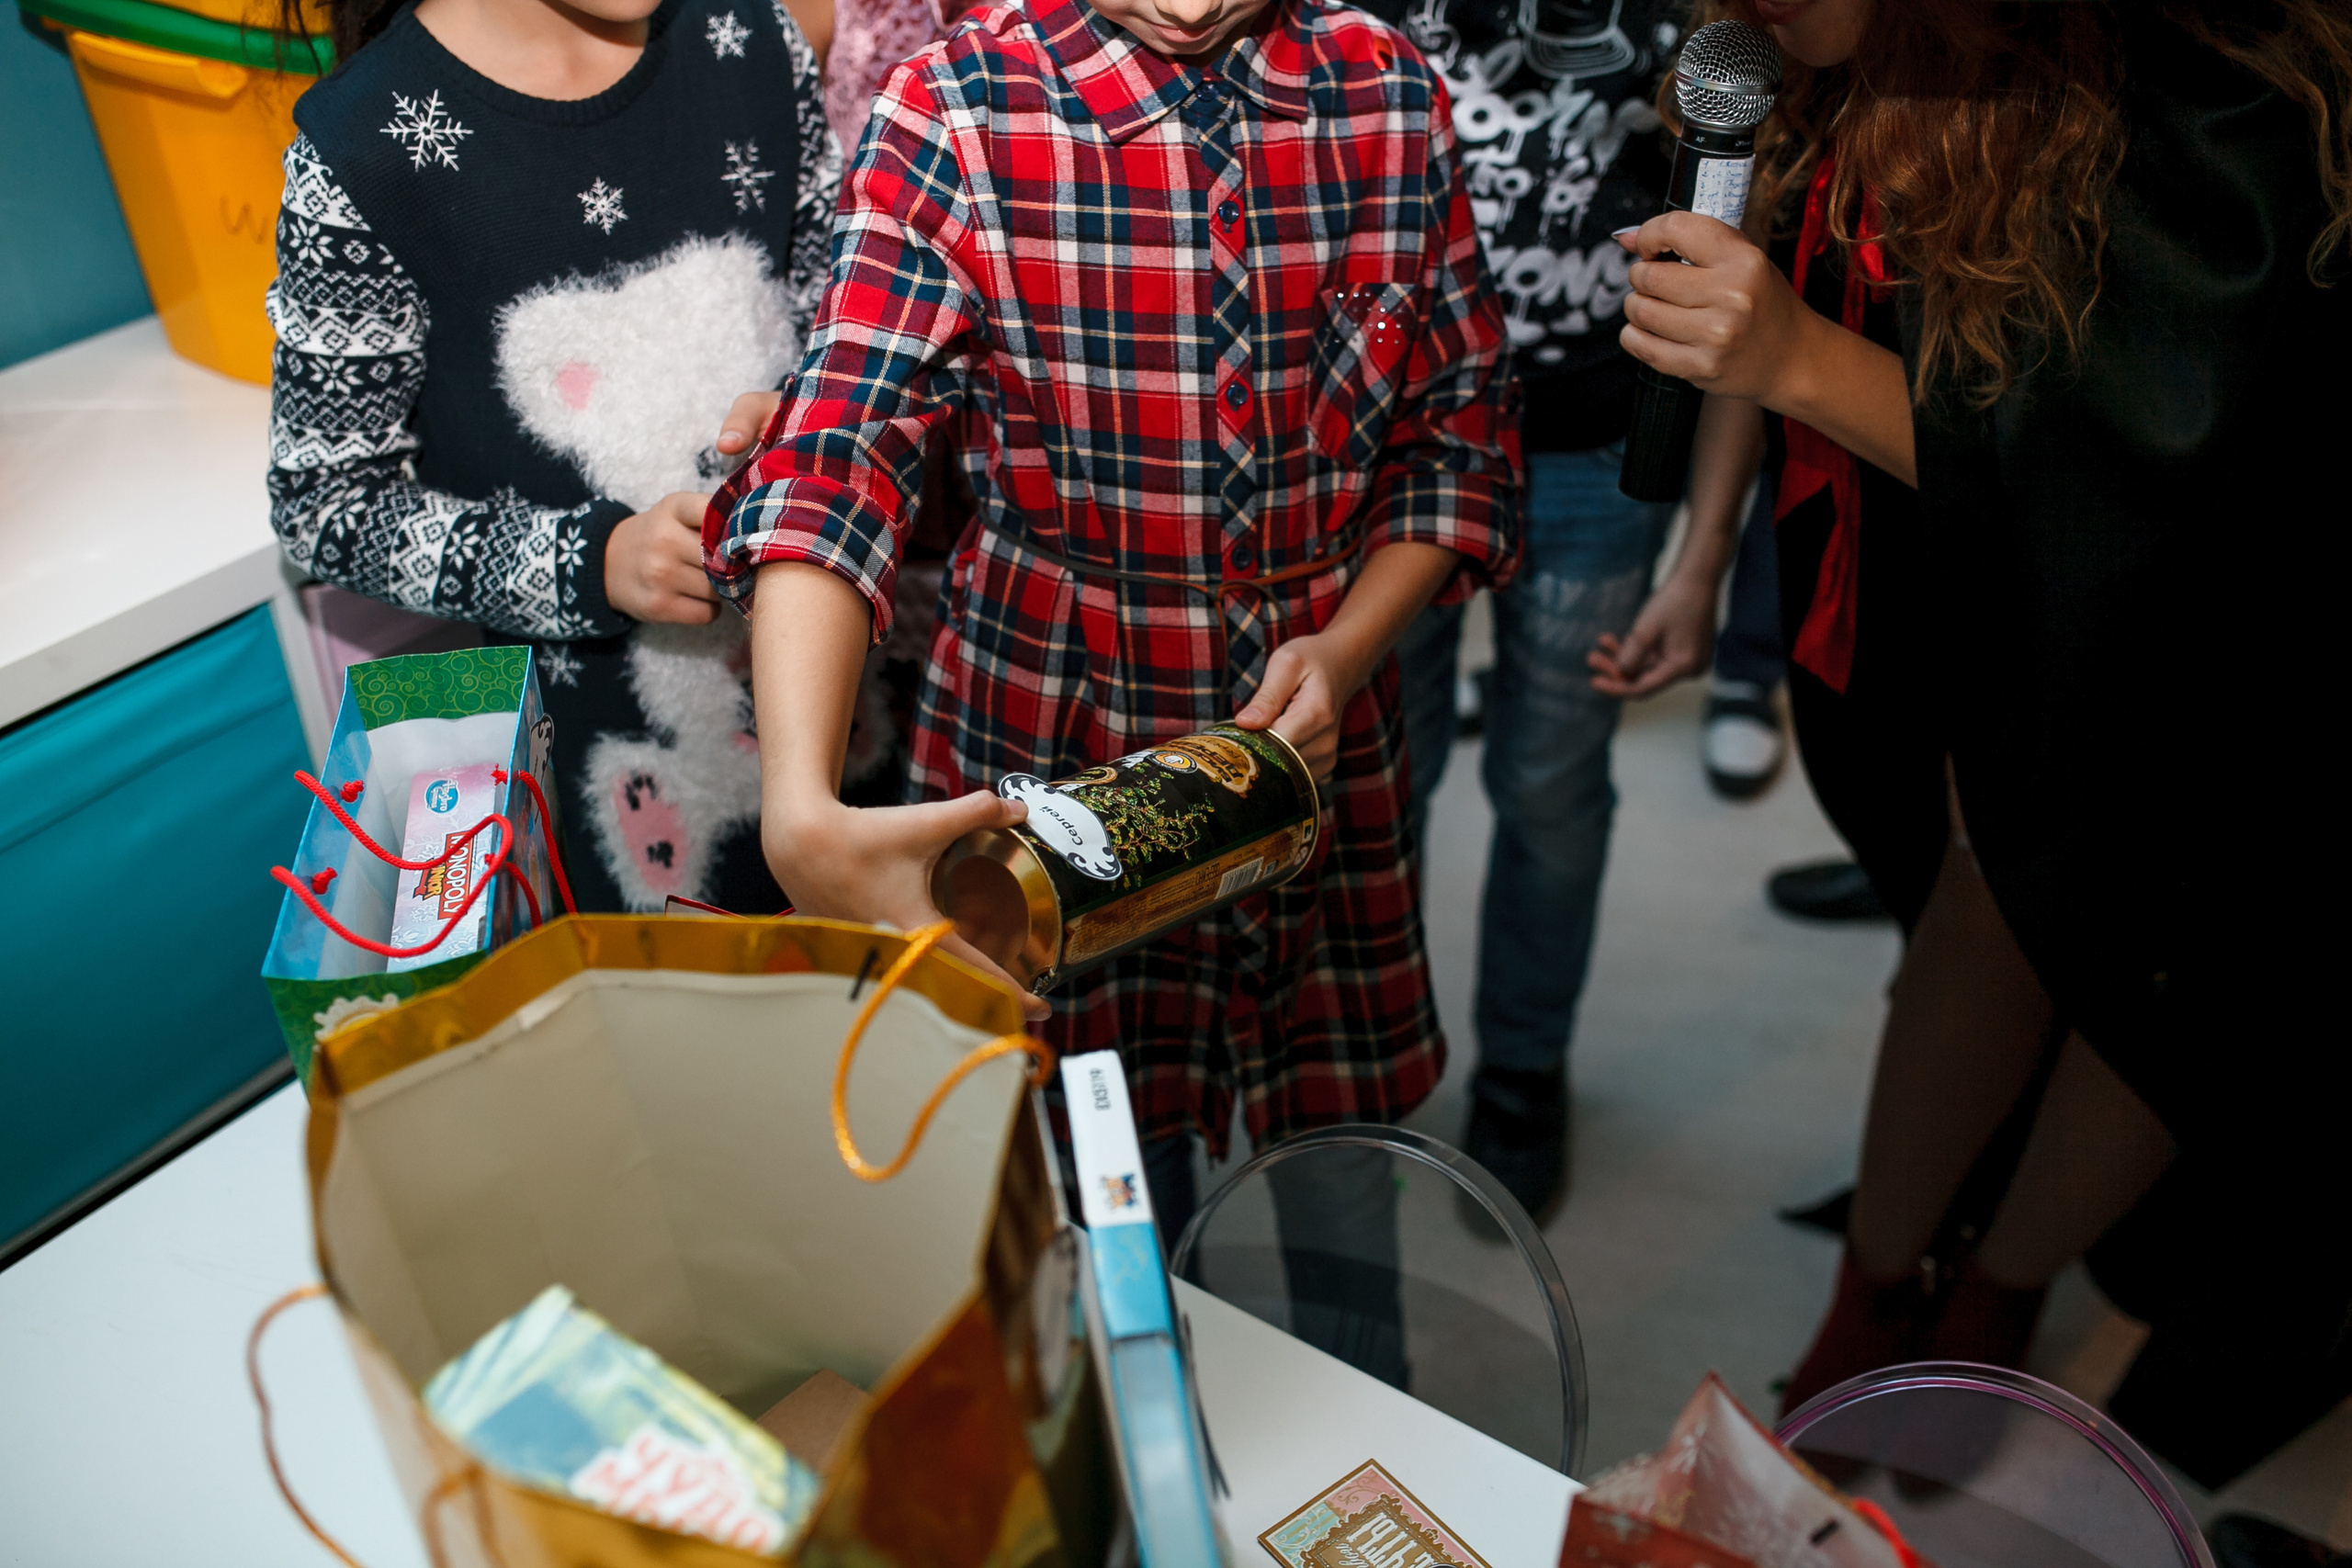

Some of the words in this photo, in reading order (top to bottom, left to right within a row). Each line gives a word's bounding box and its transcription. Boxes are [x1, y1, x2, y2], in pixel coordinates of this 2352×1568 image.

[438, 780, 457, 812] Hasbro
[1038, 806, 1084, 846] Сергей
[424, 861, 447, 900] UNIOR
[443, 835, 469, 913] MONOPOLY
